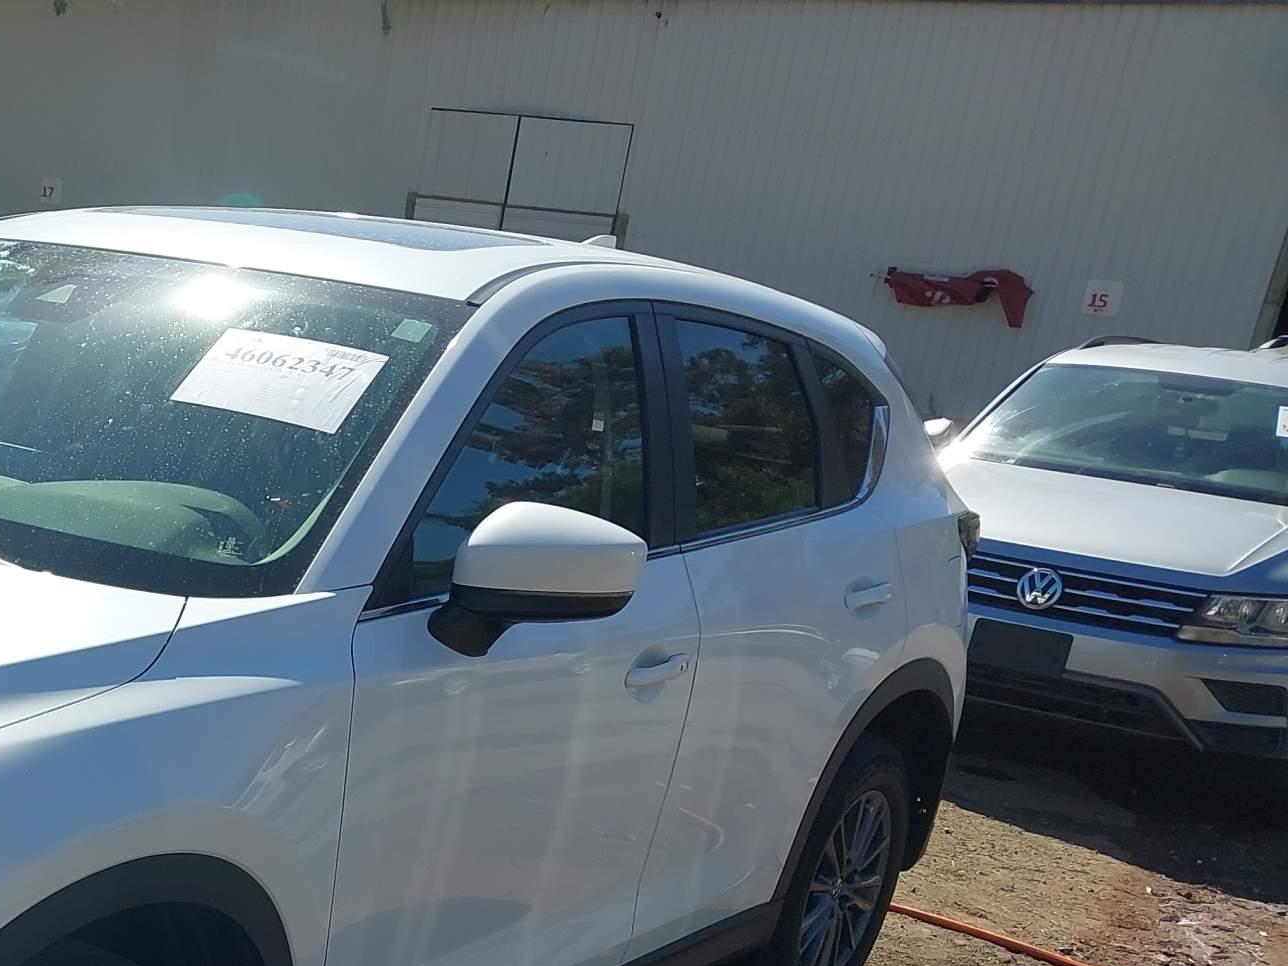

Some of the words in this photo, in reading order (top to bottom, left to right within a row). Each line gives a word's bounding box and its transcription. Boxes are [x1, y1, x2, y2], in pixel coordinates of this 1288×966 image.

[41, 185, 55, 198] 17
[1087, 293, 1109, 308] 15
[224, 347, 355, 380] 46062347
